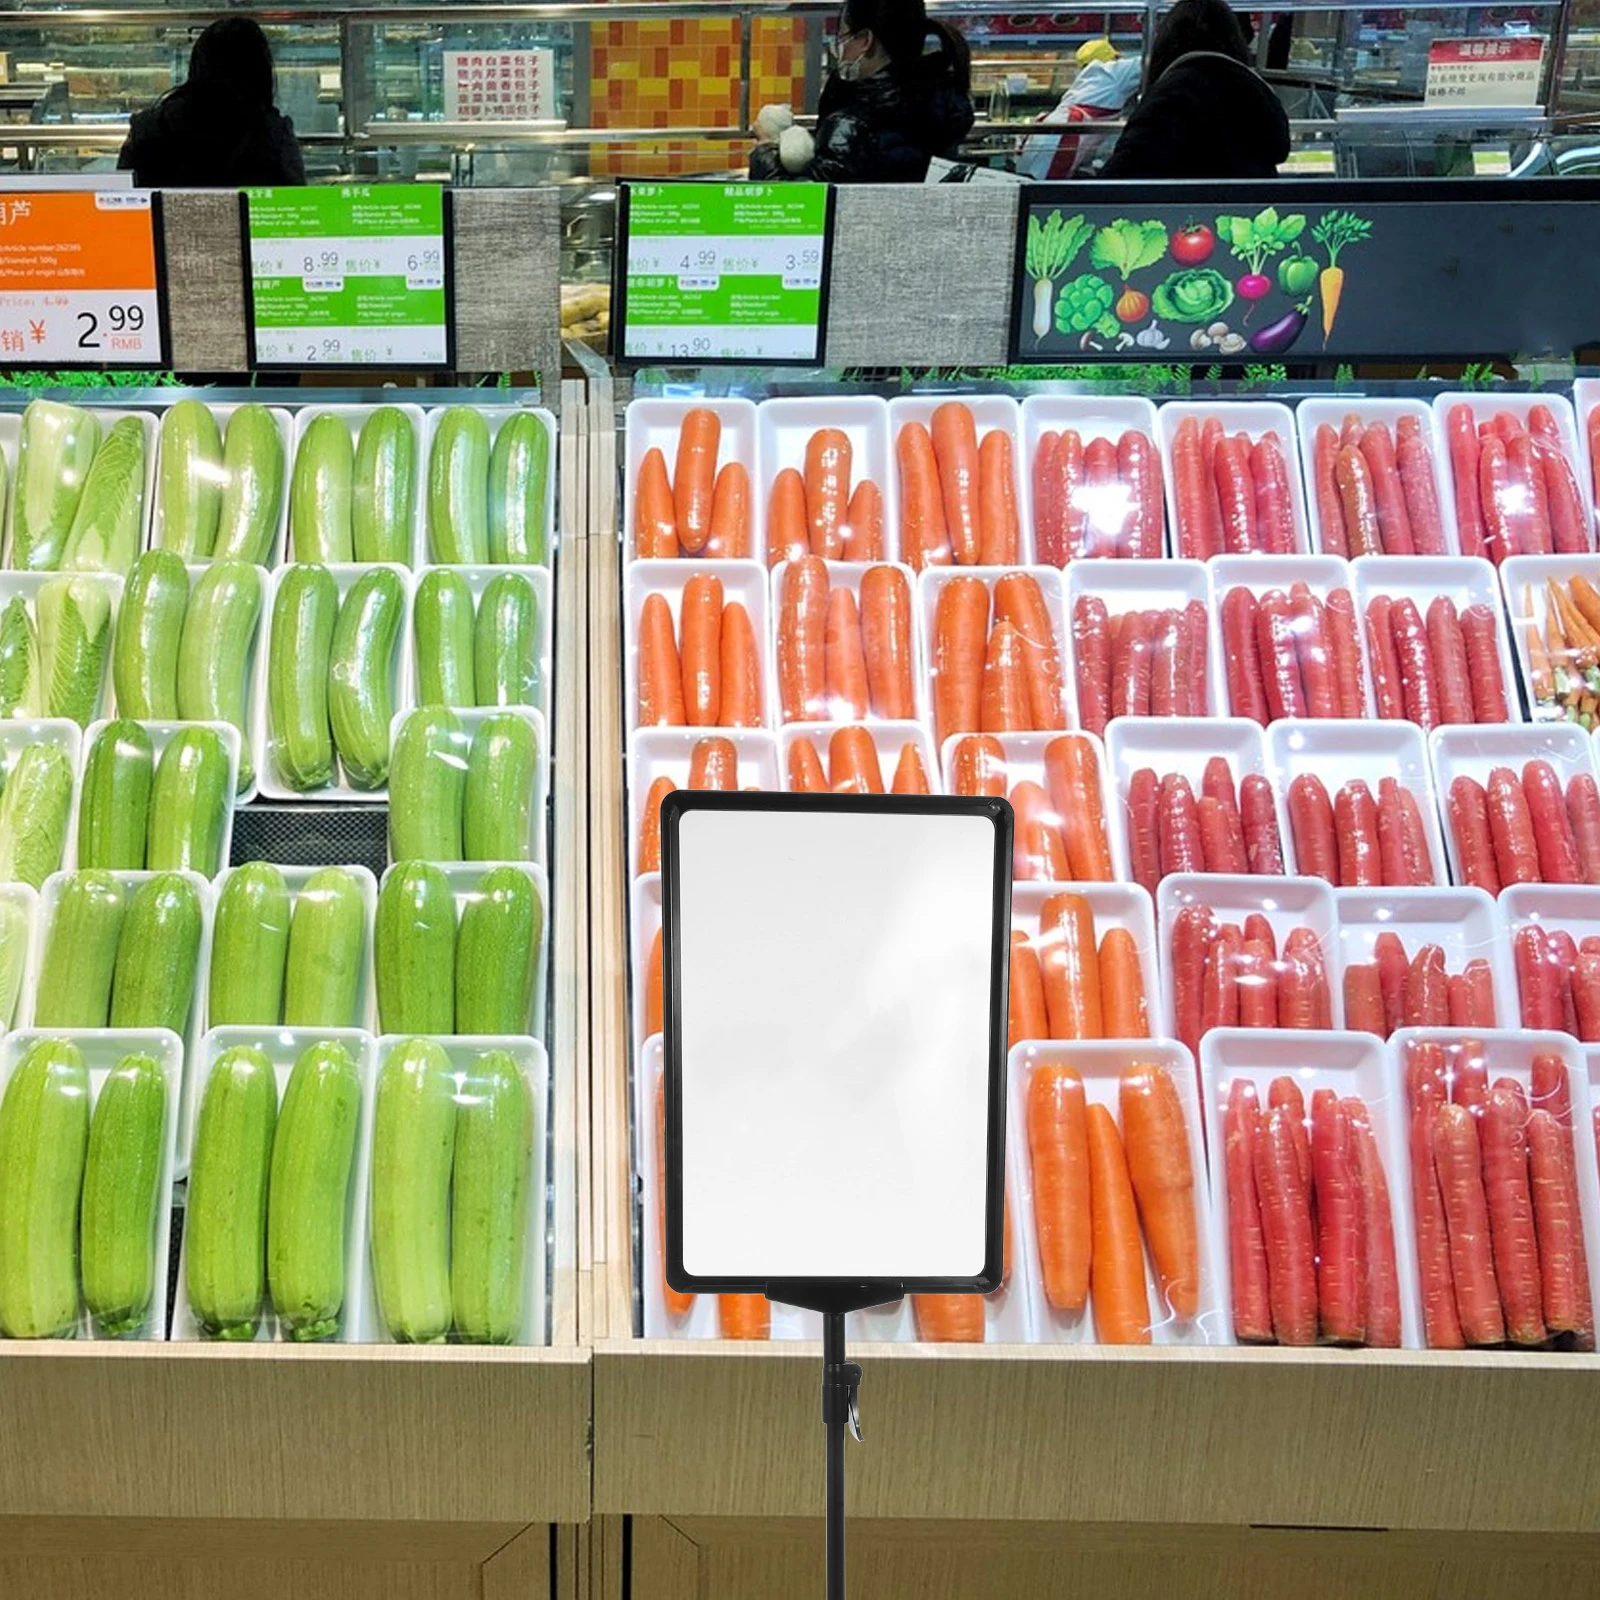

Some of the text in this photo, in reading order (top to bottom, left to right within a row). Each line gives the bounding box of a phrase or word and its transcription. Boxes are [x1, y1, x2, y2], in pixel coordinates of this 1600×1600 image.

[304, 252, 339, 272] 8.99
[408, 250, 441, 271] 6.99
[680, 250, 716, 270] 4.99
[785, 250, 819, 270] 3.59
[111, 339, 142, 350] RMB
[306, 339, 340, 362] 2.99
